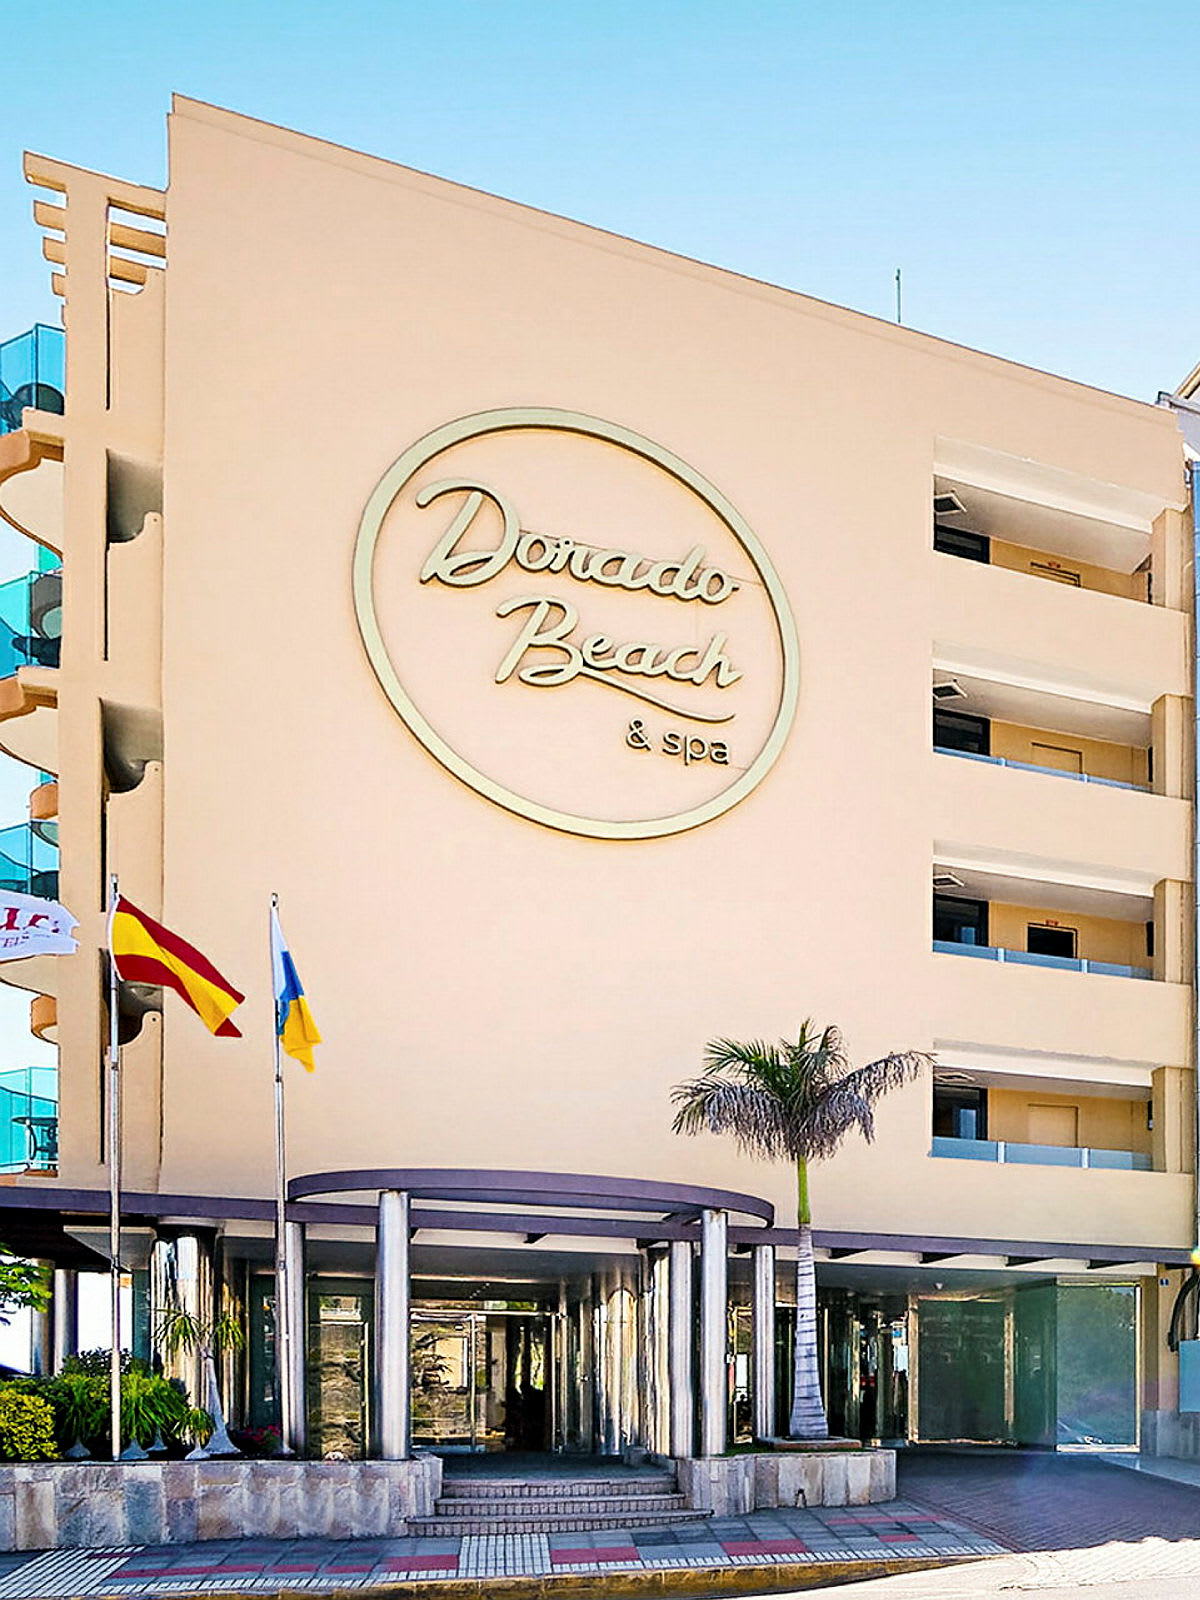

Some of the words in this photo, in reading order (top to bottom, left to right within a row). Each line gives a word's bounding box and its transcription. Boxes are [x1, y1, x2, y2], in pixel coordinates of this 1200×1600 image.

[416, 477, 740, 605] Dorado
[495, 595, 744, 723] Beach
[626, 719, 652, 752] &
[662, 728, 731, 767] spa
